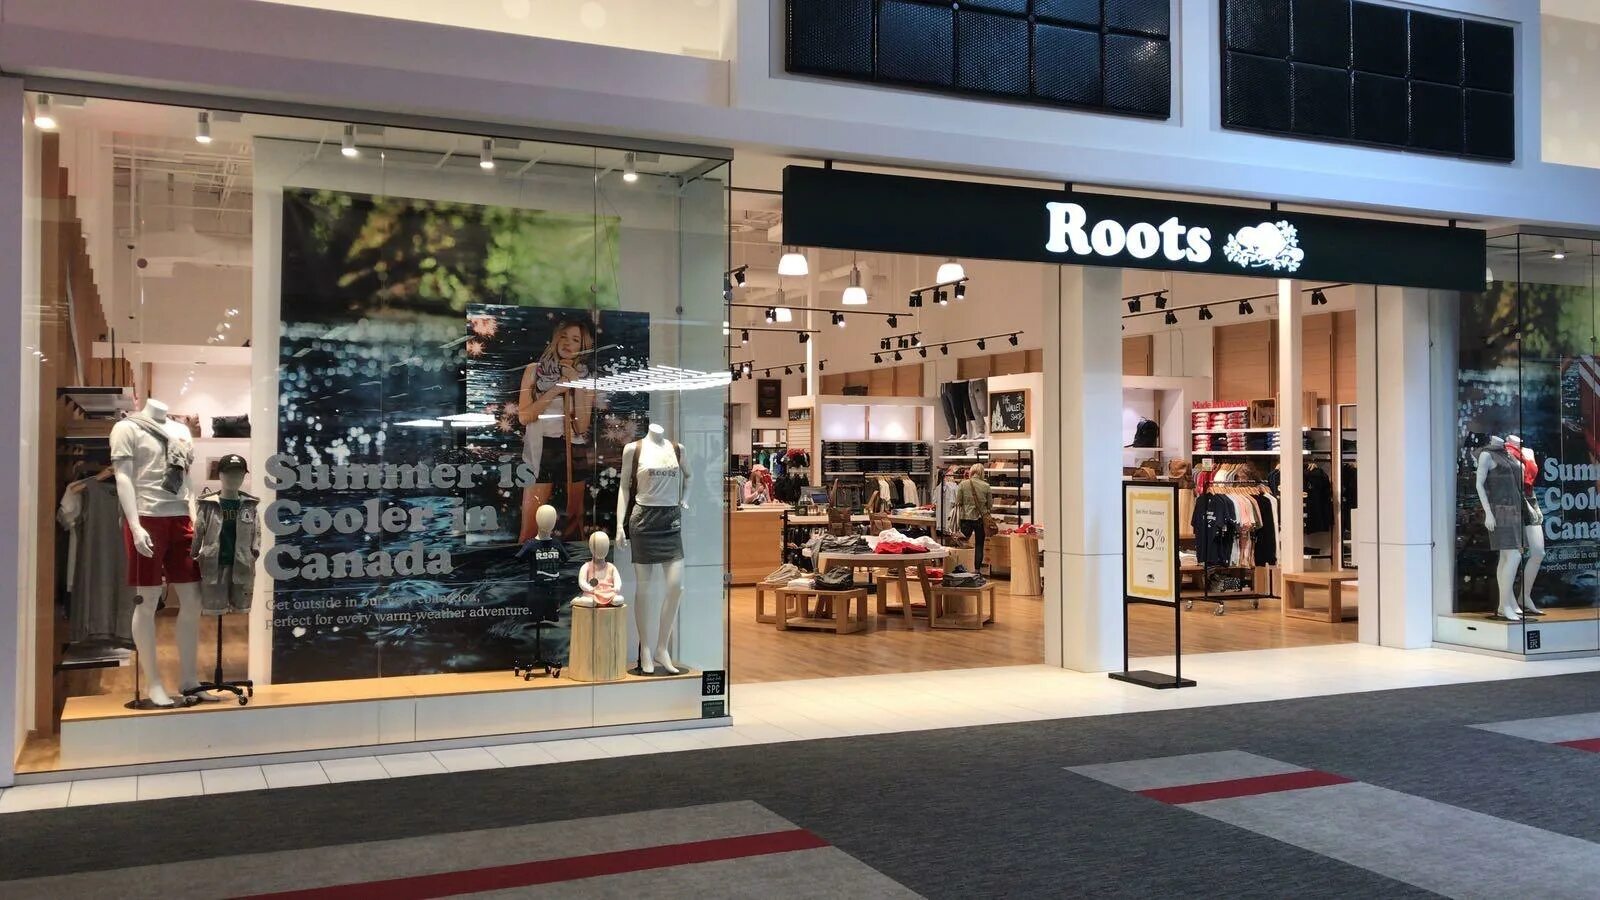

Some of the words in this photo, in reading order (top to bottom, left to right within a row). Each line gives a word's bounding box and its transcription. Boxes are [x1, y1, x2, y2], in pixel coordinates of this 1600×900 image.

[1046, 201, 1211, 263] Roots
[1005, 403, 1021, 412] WALLET
[1011, 413, 1023, 421] SHOP
[264, 454, 483, 490] Summer
[498, 456, 537, 489] is
[1544, 457, 1600, 481] Sum
[264, 499, 434, 535] Cooler
[449, 497, 499, 533] in
[1135, 526, 1166, 550] 25%
[264, 541, 454, 581] Canada
[265, 598, 290, 611] Get
[293, 596, 341, 610] outside
[345, 596, 357, 607] in
[265, 615, 314, 630] perfect
[315, 613, 333, 625] for
[337, 613, 372, 625] every
[375, 608, 466, 623] warm-weather
[469, 605, 533, 618] adventure.
